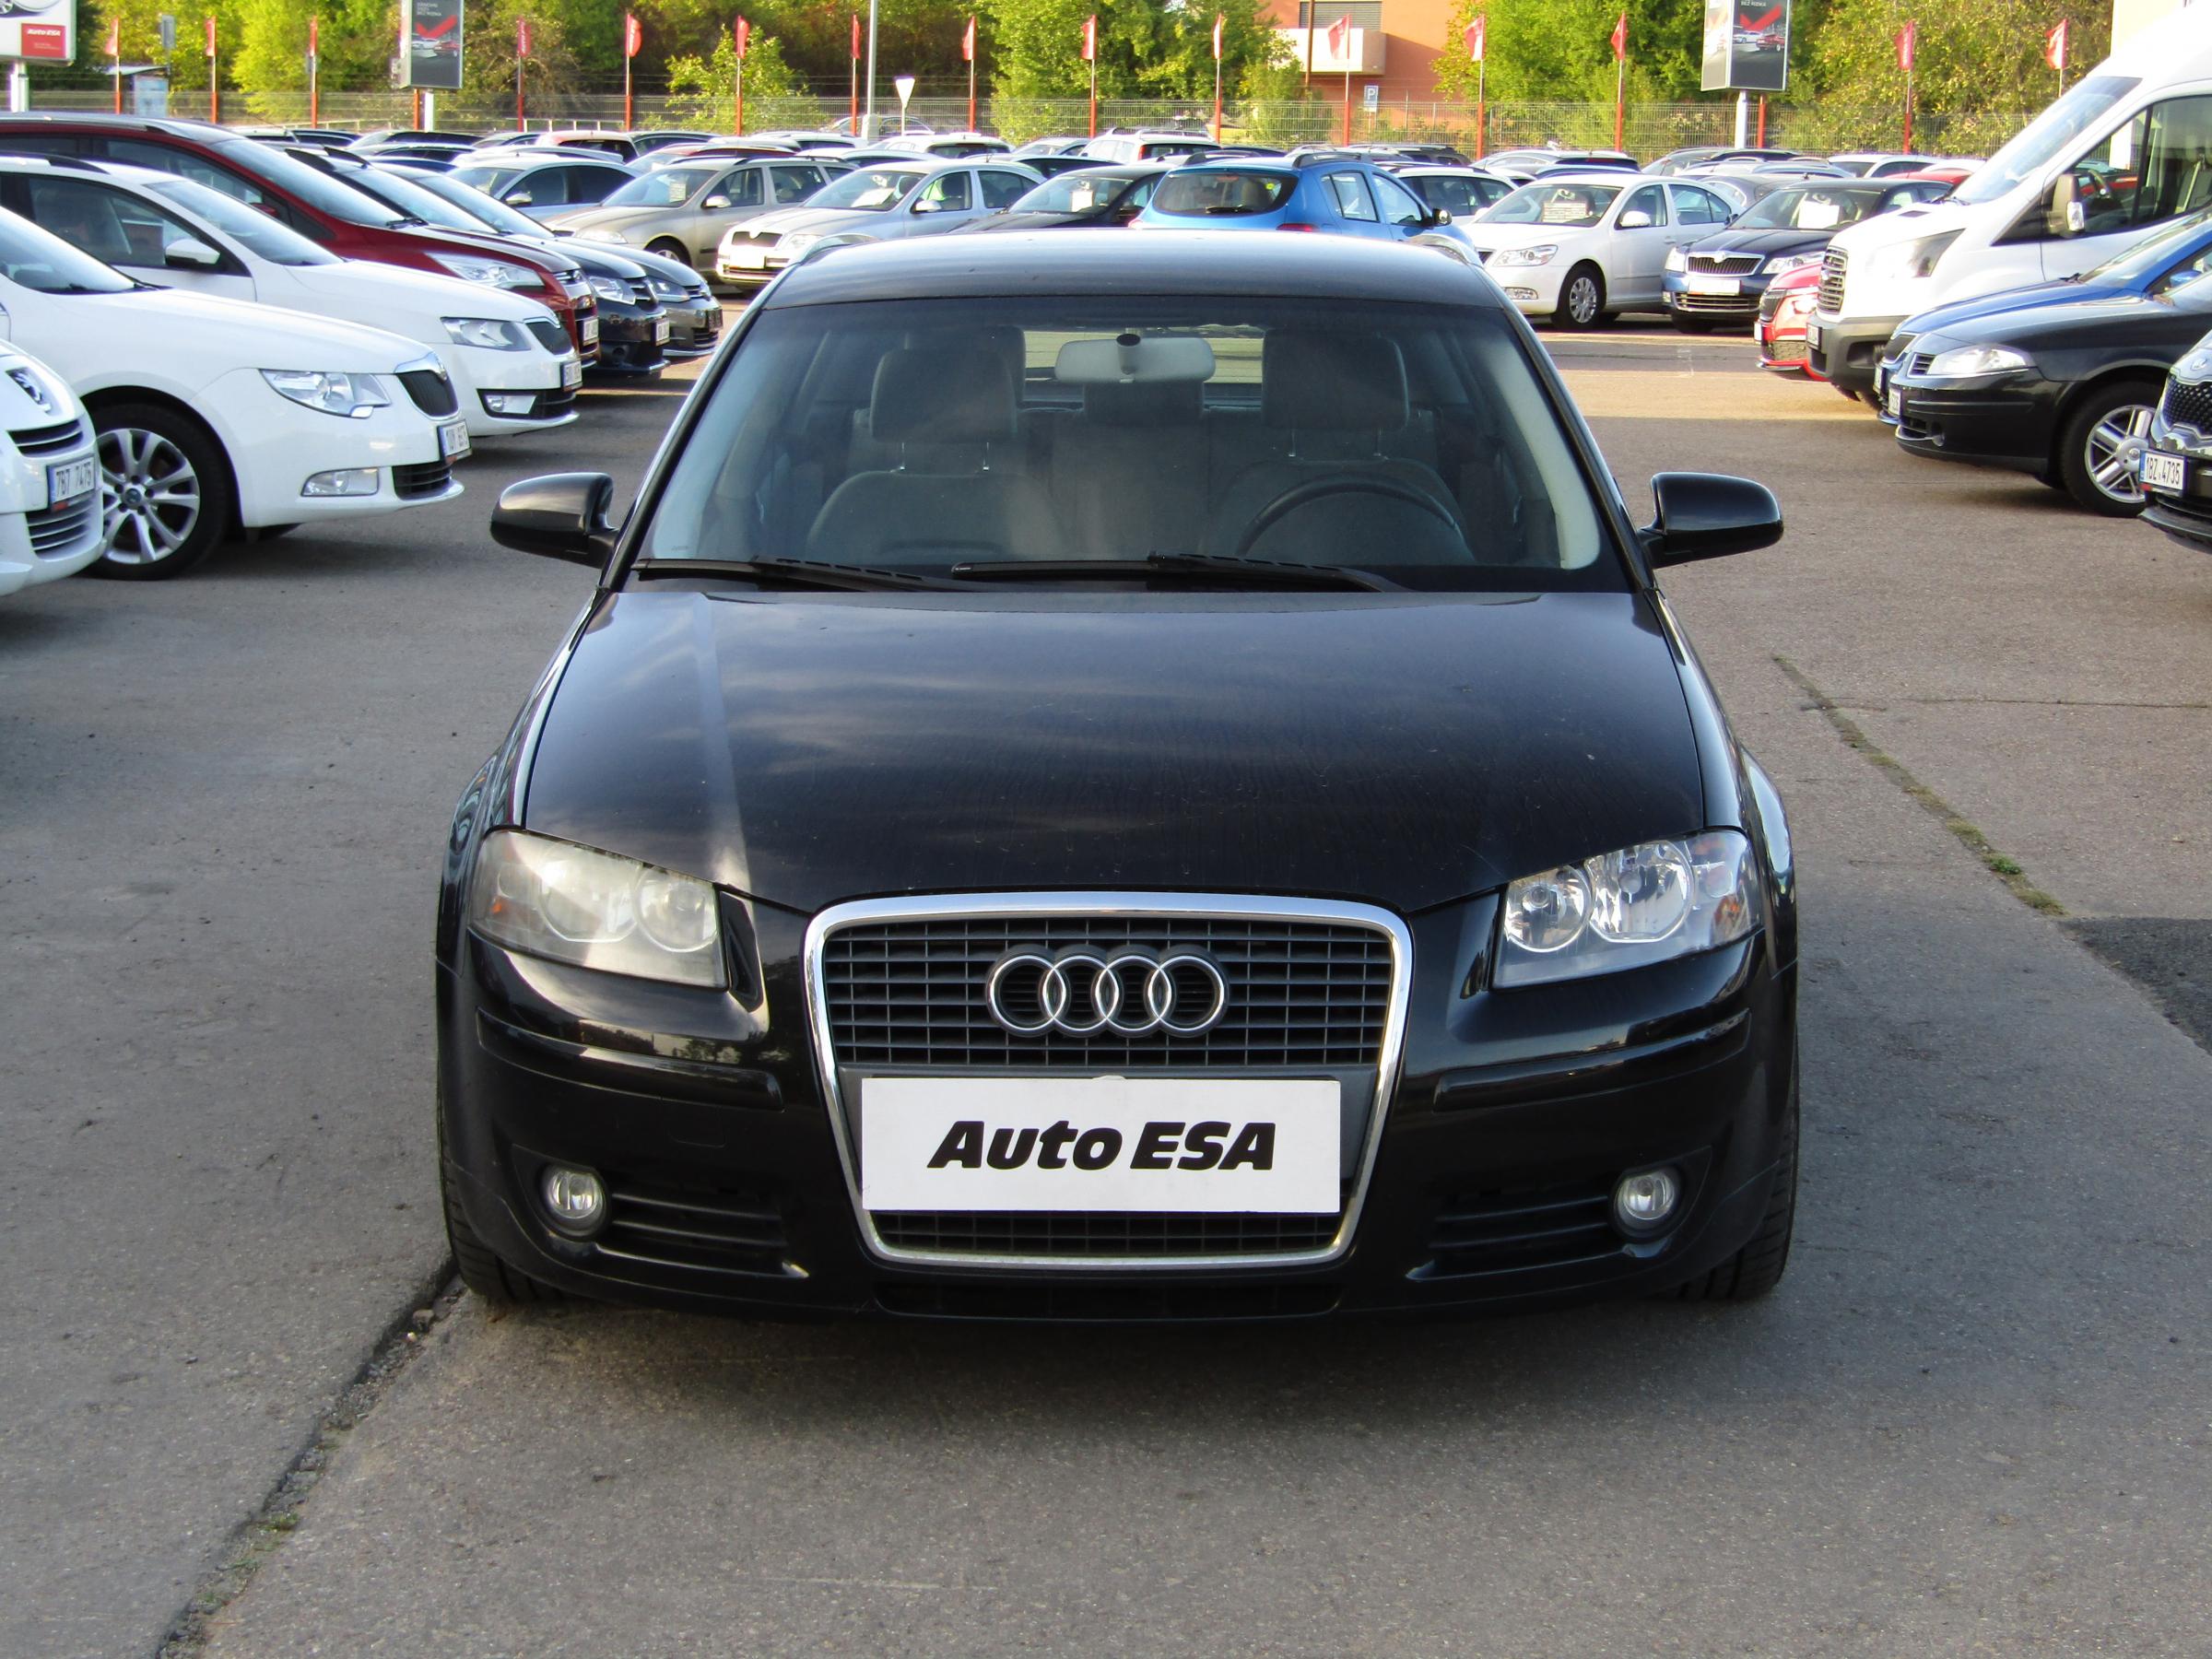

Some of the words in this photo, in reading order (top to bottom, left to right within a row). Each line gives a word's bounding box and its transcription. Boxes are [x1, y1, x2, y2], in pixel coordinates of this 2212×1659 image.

[1367, 88, 1375, 100] P
[2161, 460, 2181, 485] 4735
[927, 1120, 1123, 1171] Auto
[1130, 1121, 1277, 1171] ESA
